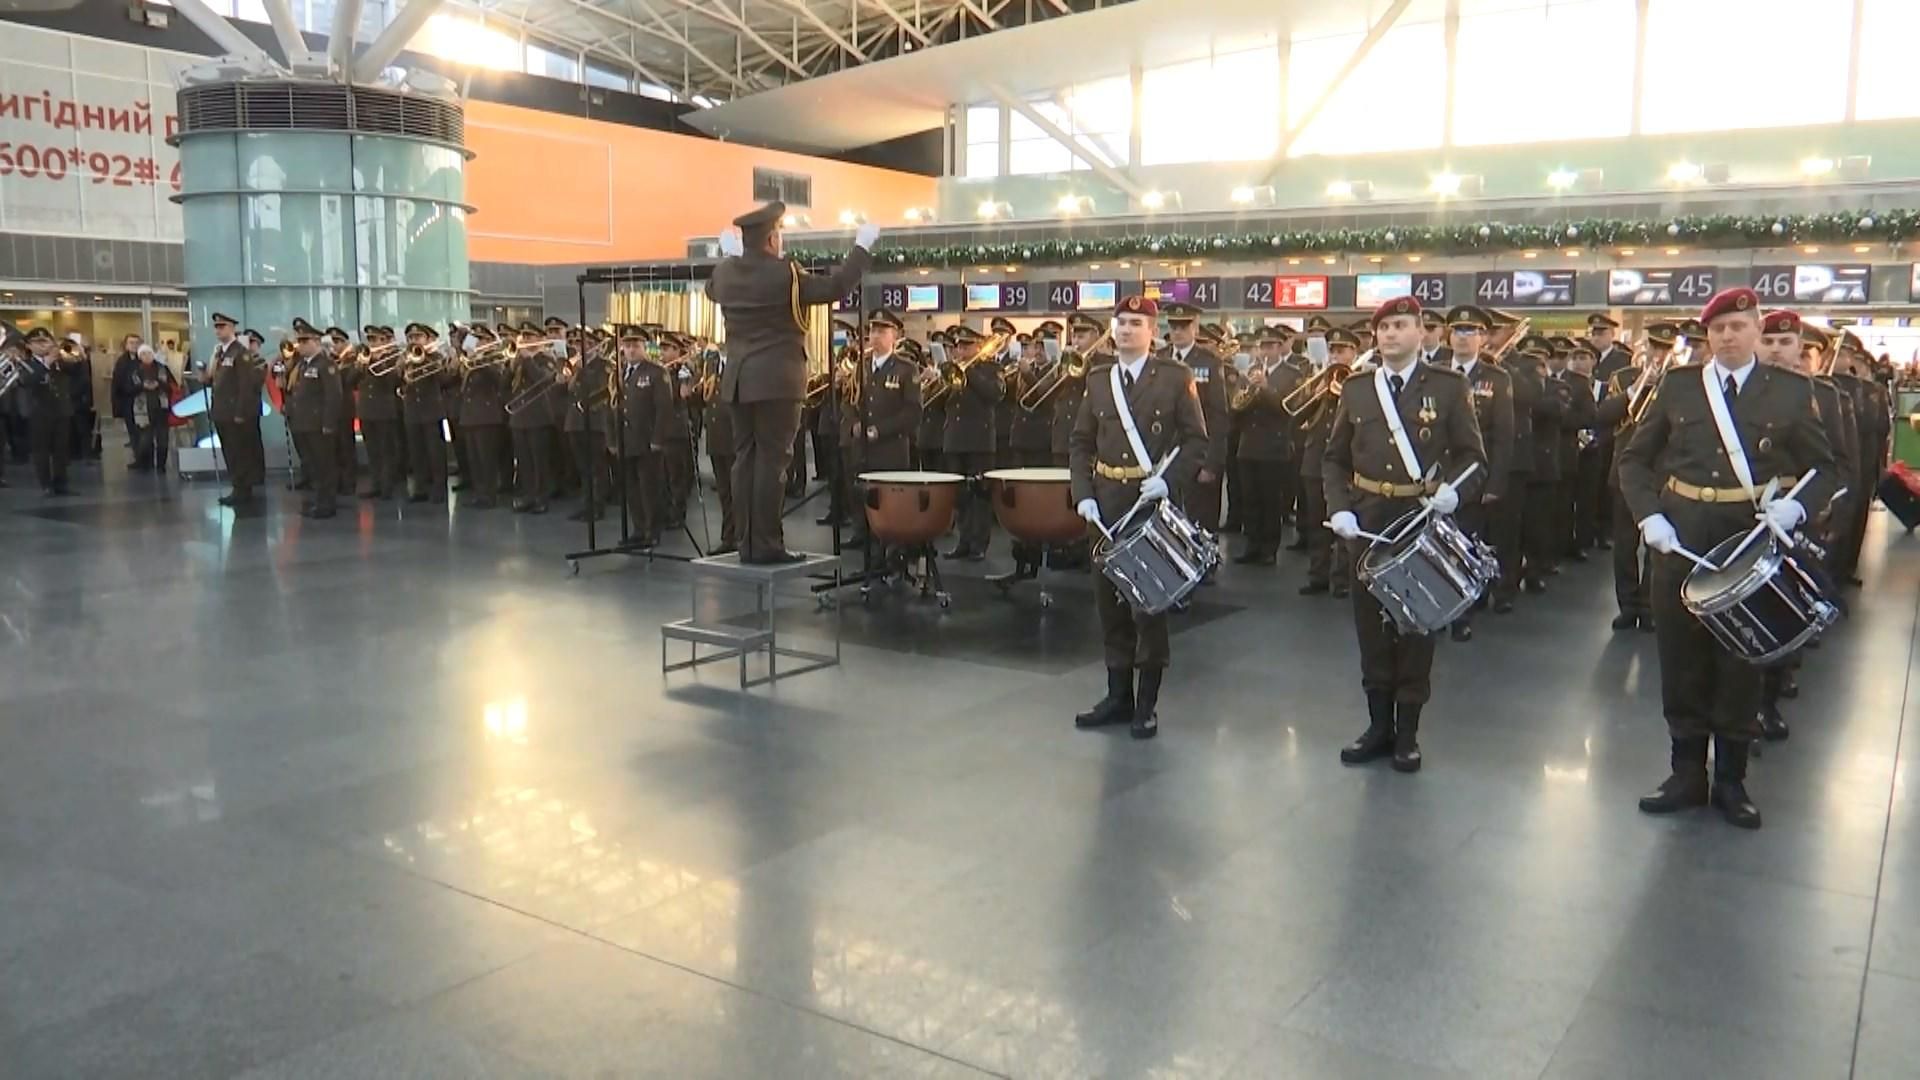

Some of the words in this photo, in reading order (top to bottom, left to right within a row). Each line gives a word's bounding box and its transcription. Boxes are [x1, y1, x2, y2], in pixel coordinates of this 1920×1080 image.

[1194, 283, 1218, 302] 41
[1247, 283, 1272, 302] 42
[1415, 280, 1444, 300] 43
[1478, 278, 1509, 300] 44
[1678, 274, 1713, 297] 45
[1754, 273, 1790, 297] 46
[883, 289, 902, 307] 38
[1005, 287, 1026, 306] 39
[1051, 287, 1074, 306] 40
